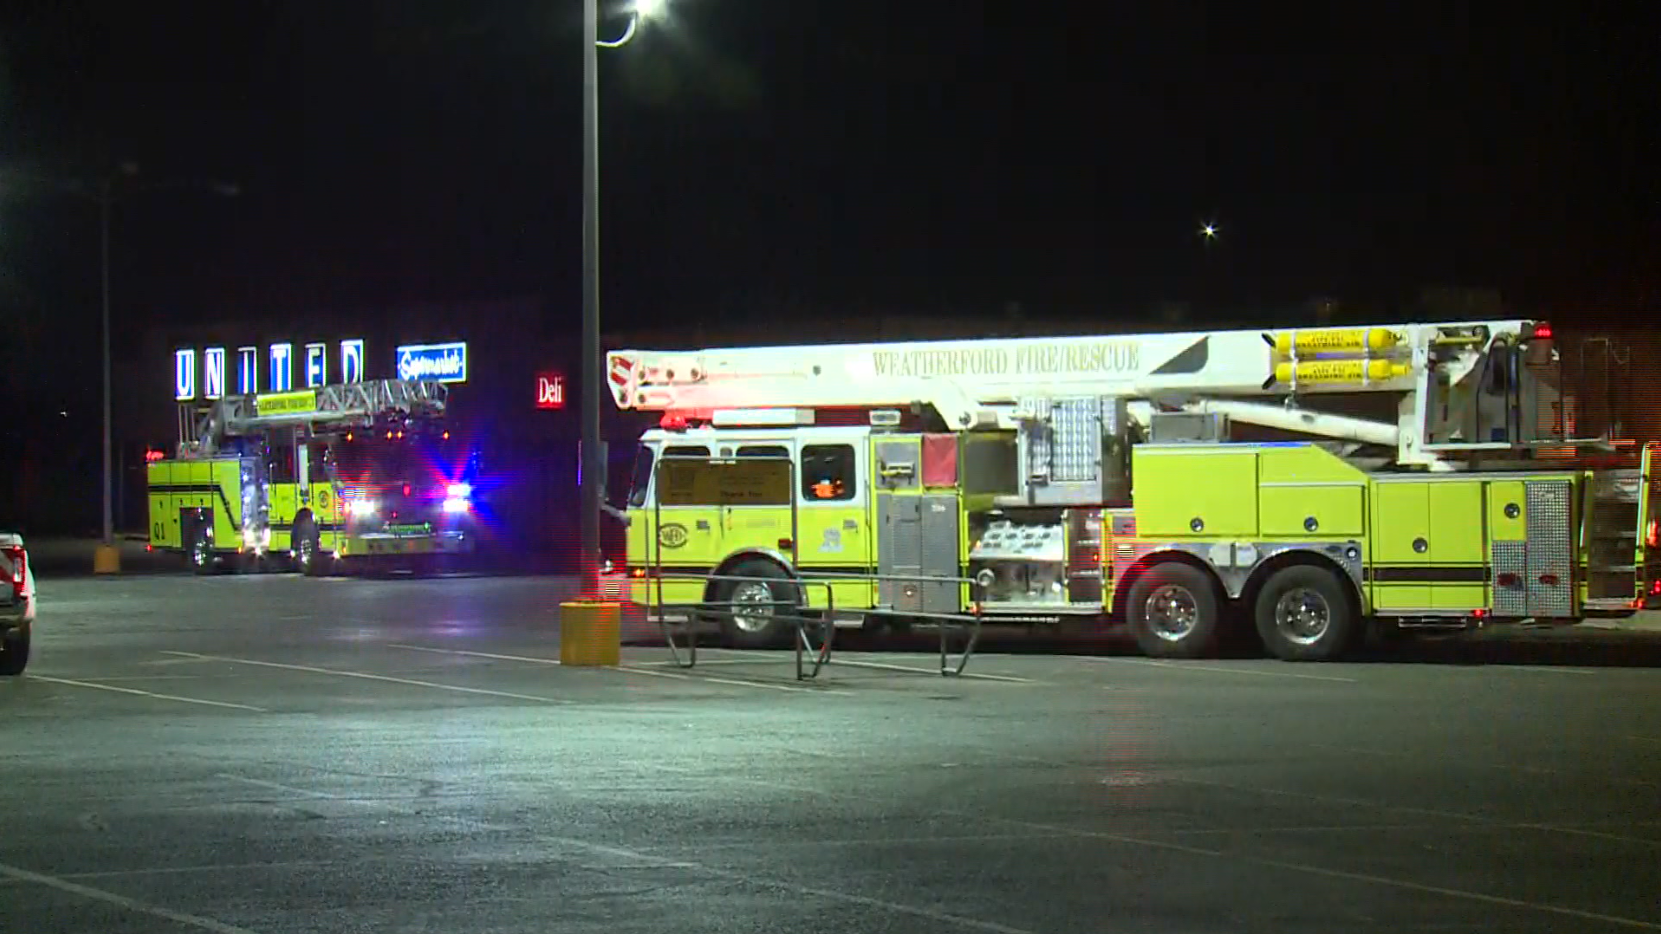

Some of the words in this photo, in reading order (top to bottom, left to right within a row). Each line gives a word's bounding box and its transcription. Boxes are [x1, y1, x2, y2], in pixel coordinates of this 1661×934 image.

[177, 341, 363, 398] UNITED
[400, 347, 460, 381] Supermarket
[872, 347, 1008, 377] WEATHERFORD
[1015, 341, 1140, 374] FIRE/RESCUE
[538, 376, 563, 403] Deli
[153, 521, 166, 541] Q1
